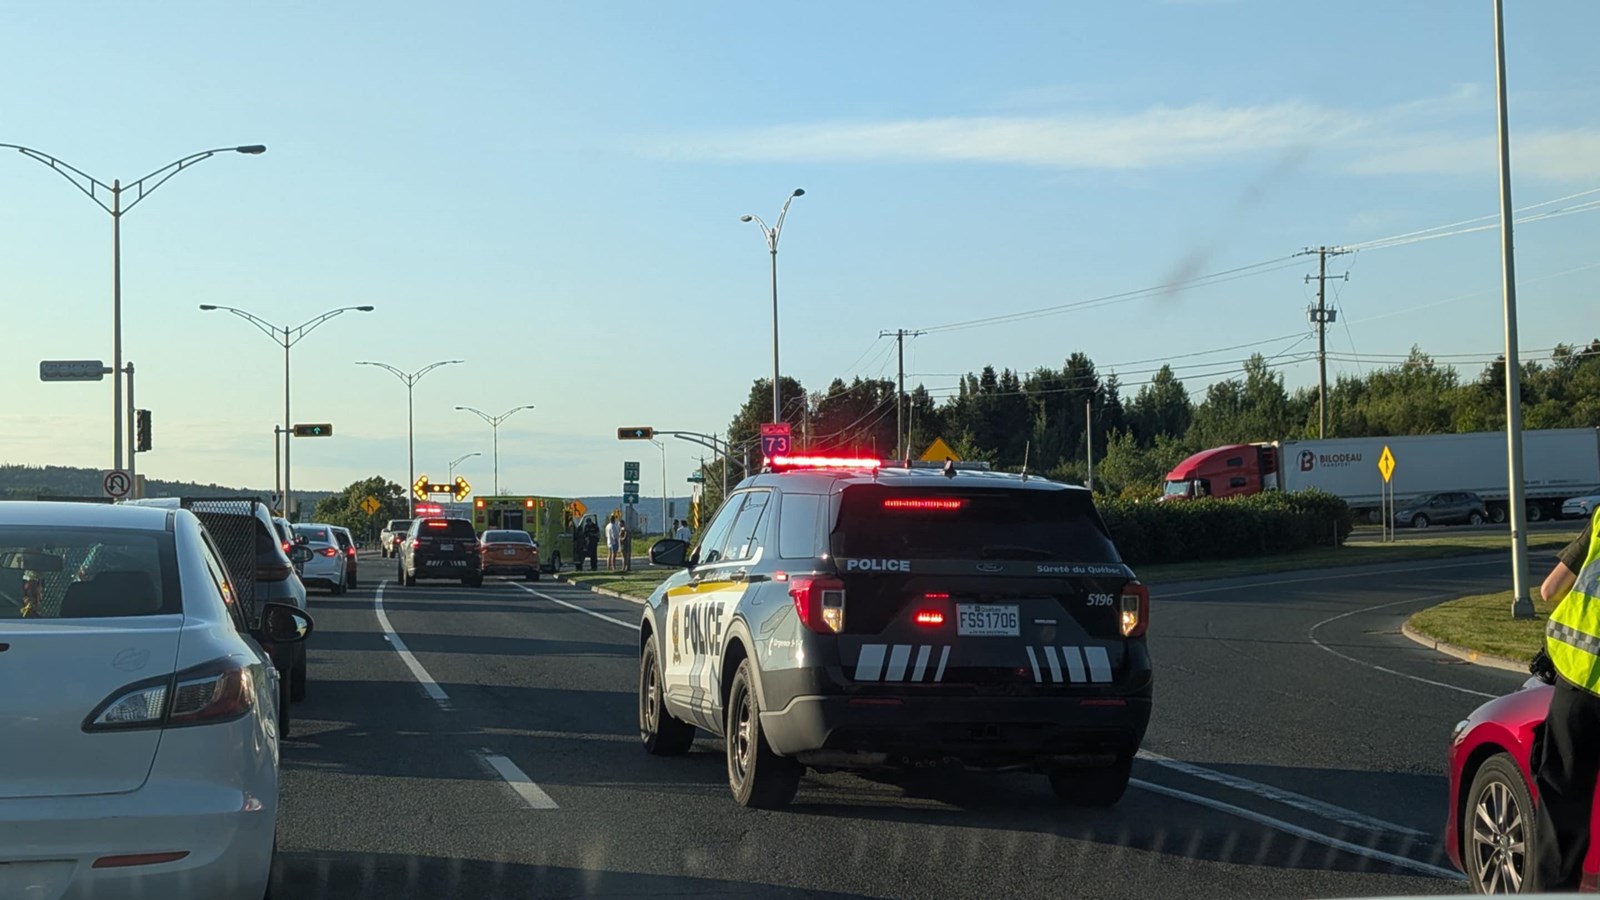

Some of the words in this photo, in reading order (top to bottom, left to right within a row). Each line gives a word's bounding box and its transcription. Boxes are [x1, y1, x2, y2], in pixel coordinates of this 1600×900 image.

[766, 437, 786, 452] 73
[1320, 453, 1362, 463] BILODEAU
[626, 470, 638, 479] 173
[847, 559, 911, 572] POLICE
[1036, 565, 1070, 573] Sûreté
[1072, 565, 1086, 573] du
[1088, 566, 1121, 575] Québec
[1086, 593, 1114, 606] 5196
[960, 612, 1017, 629] FSS1706
[684, 601, 725, 657] POLICE
